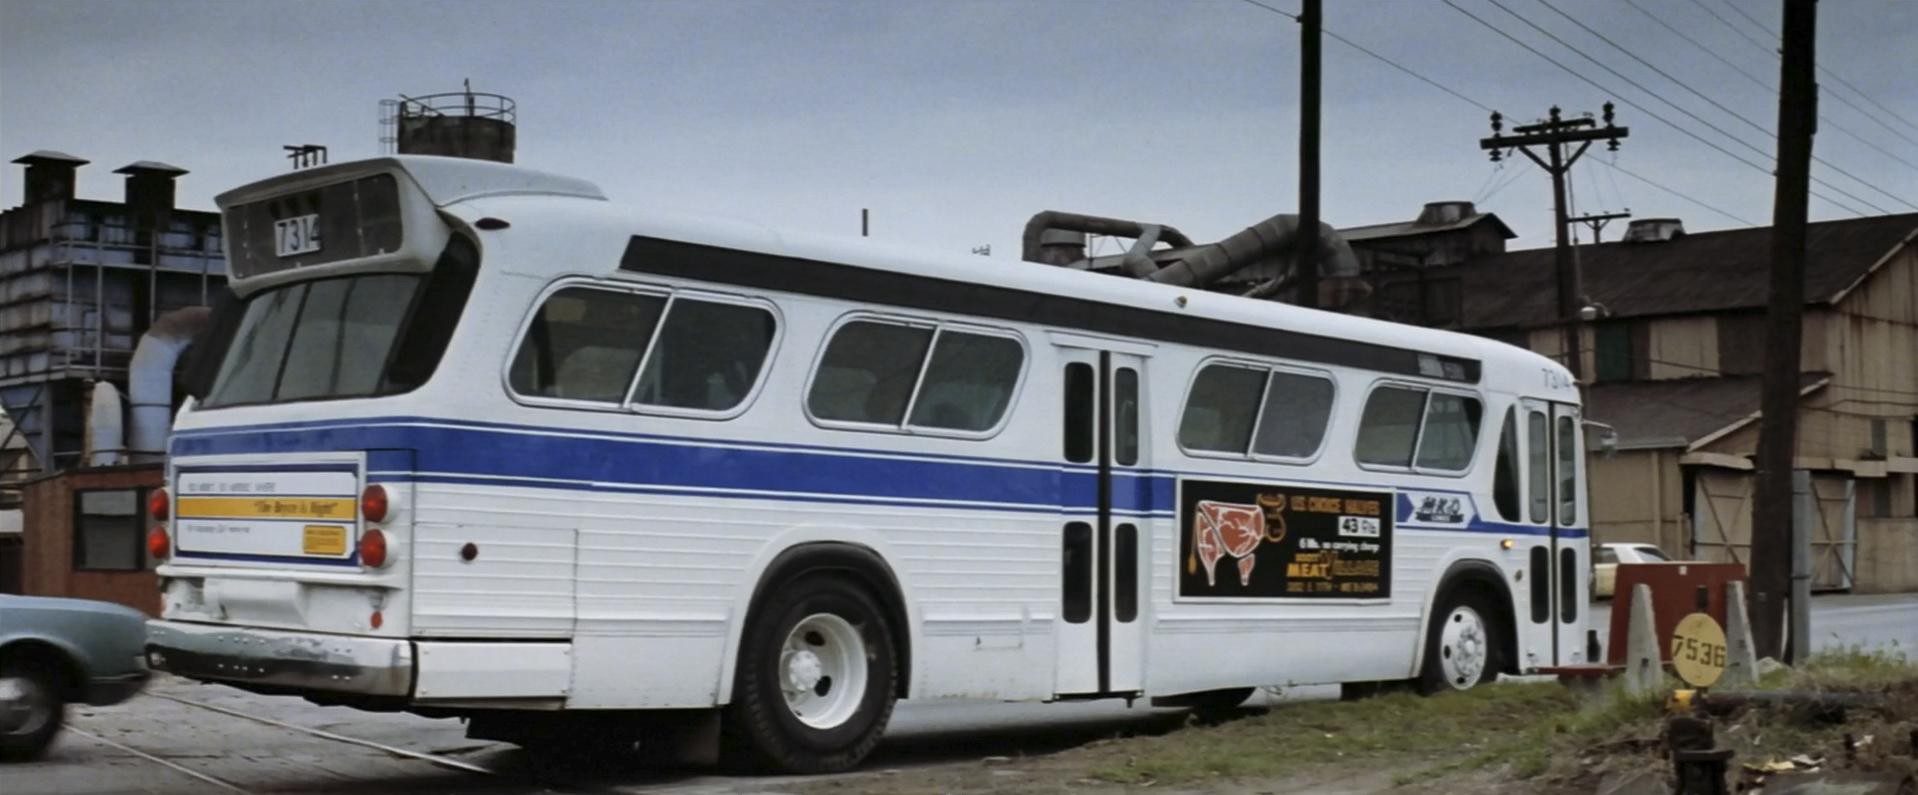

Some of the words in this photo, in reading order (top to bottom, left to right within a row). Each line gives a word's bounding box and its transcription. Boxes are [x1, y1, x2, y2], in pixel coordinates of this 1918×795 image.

[277, 217, 320, 254] 7314
[1342, 517, 1358, 534] 43
[1286, 562, 1329, 578] MEAT
[1673, 635, 1726, 667] 7536
